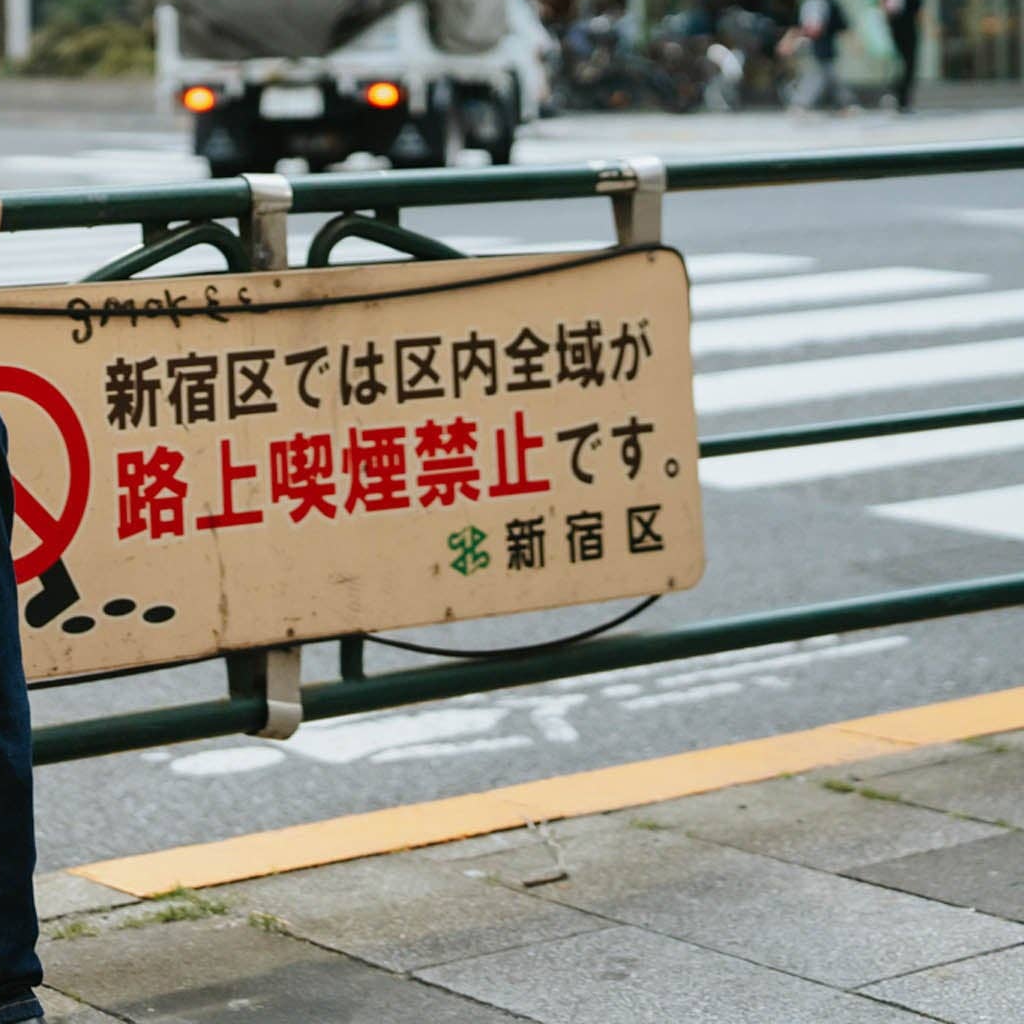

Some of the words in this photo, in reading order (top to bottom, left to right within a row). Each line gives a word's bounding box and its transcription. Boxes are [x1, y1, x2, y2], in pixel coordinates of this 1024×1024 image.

[105, 320, 653, 430] 新宿区では区内全域が
[116, 410, 681, 541] 路上喫煙禁止です。
[505, 505, 664, 571] 新宿区
